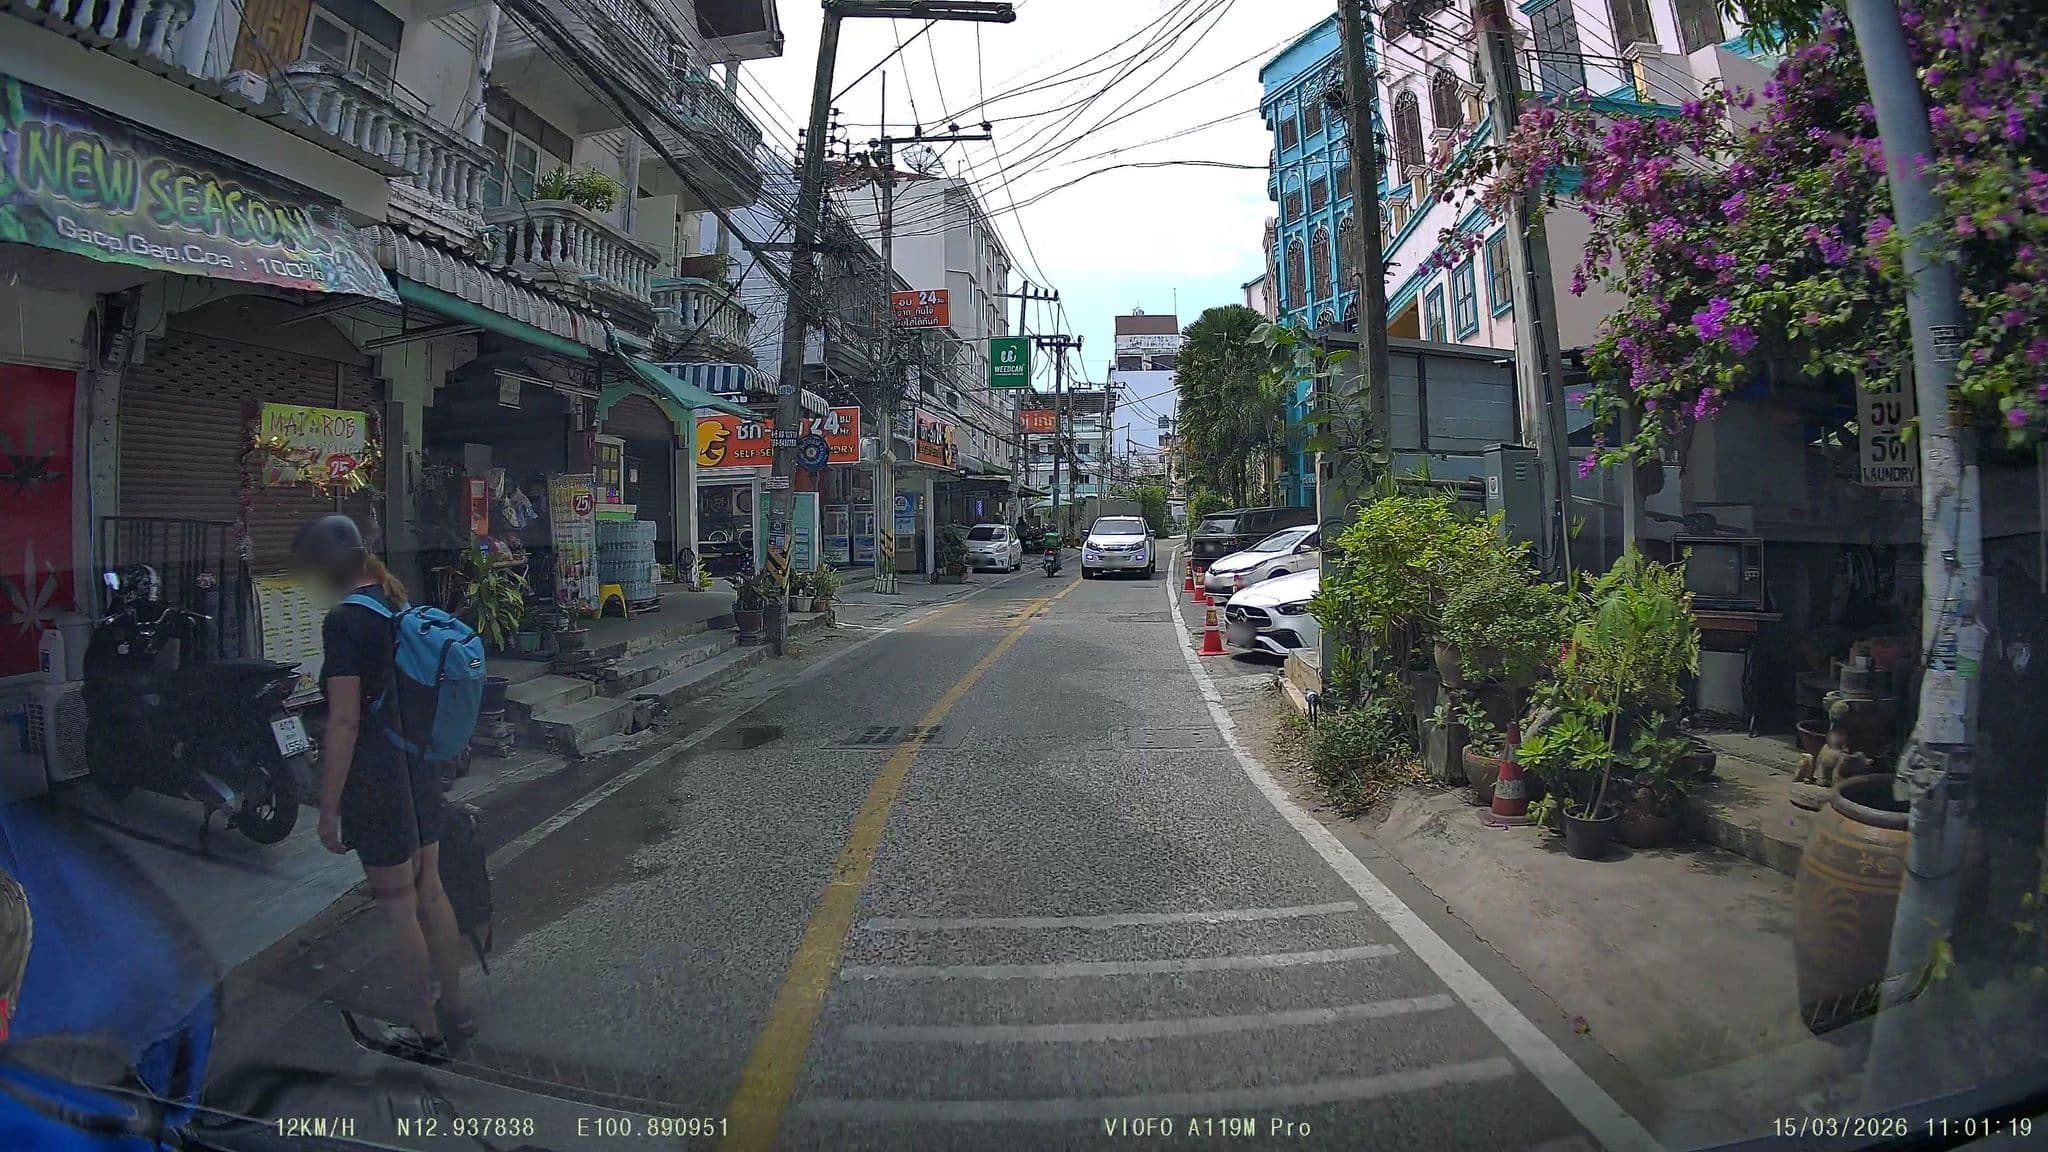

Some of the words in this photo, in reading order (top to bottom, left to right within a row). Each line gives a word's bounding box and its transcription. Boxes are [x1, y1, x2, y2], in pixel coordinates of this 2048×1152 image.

[25, 125, 136, 209] NEW
[256, 257, 325, 281] 100%
[919, 290, 937, 305] 24
[994, 365, 1024, 373] WEEDCAN
[270, 410, 305, 437] MAI
[321, 414, 356, 439] ROB
[734, 449, 756, 458] SELF
[1863, 465, 1916, 483] LAUNDRY
